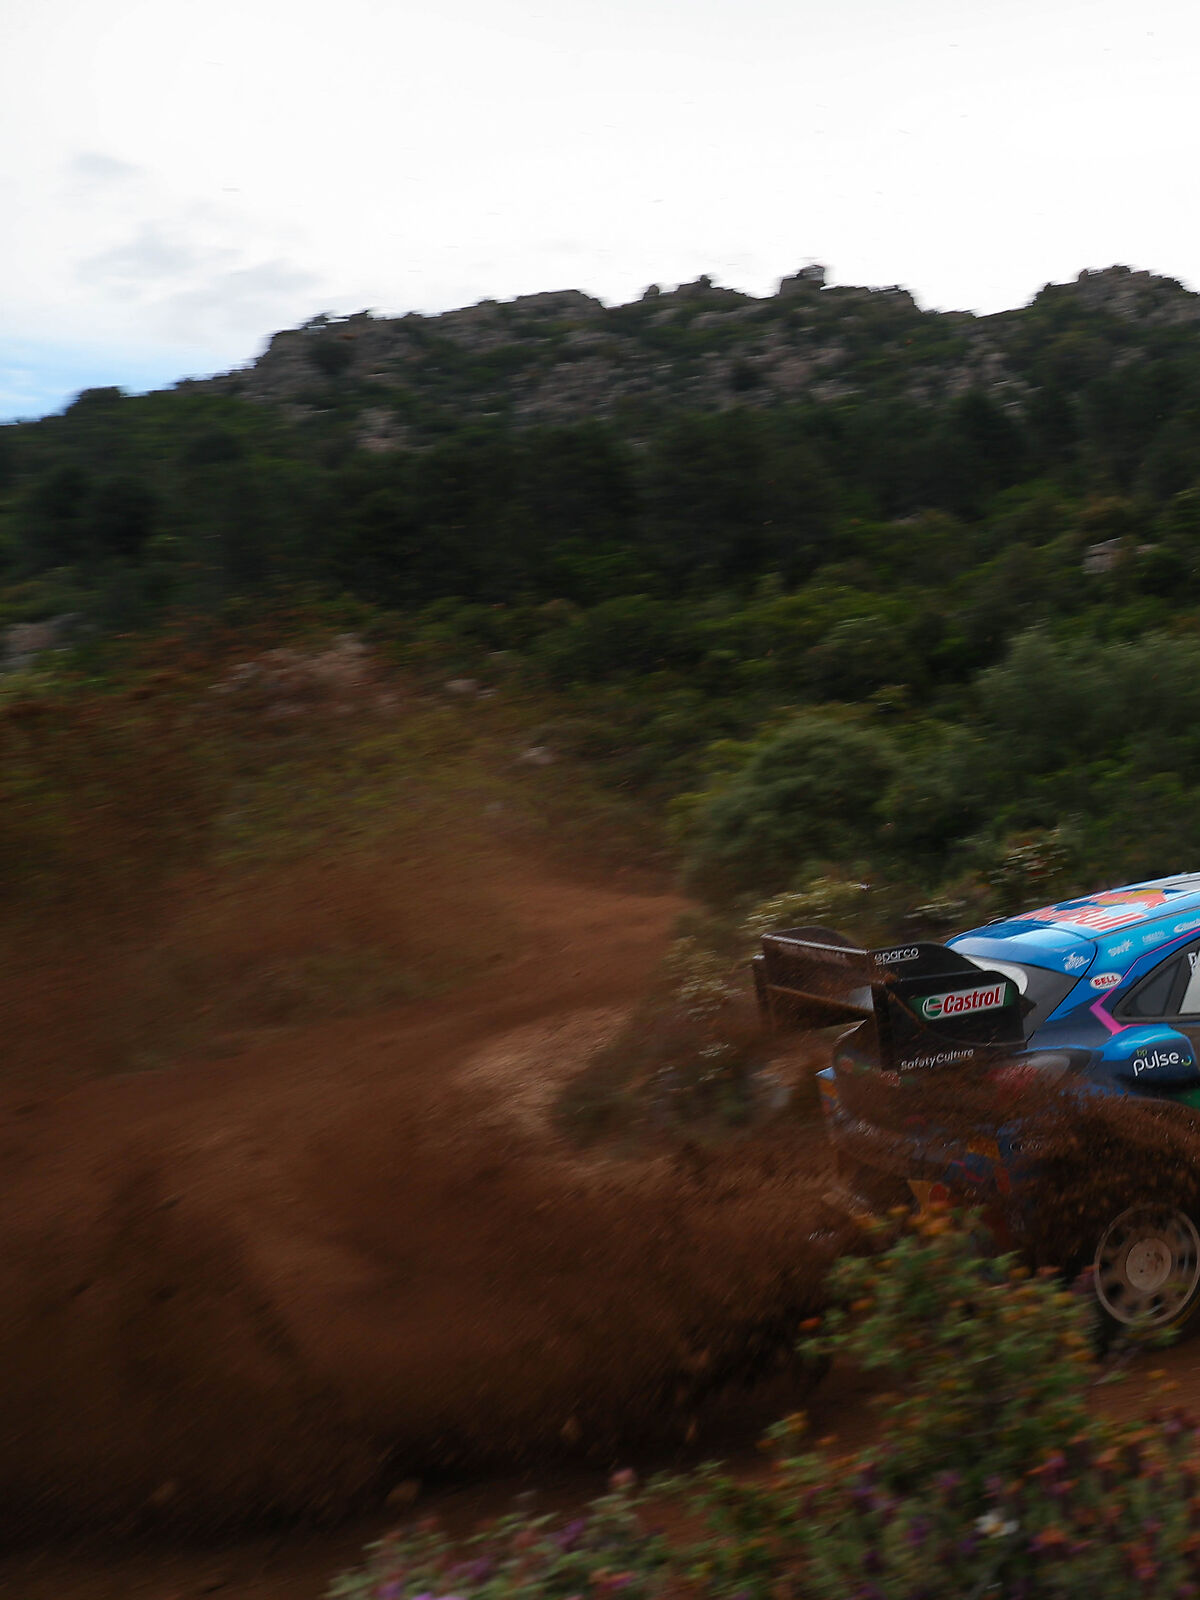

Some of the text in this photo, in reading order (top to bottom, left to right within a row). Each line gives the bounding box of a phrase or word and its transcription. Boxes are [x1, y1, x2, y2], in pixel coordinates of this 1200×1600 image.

[874, 947, 920, 965] sparco
[1094, 974, 1117, 986] BELL
[943, 986, 1000, 1014] Castrol
[1133, 1051, 1179, 1077] pulse
